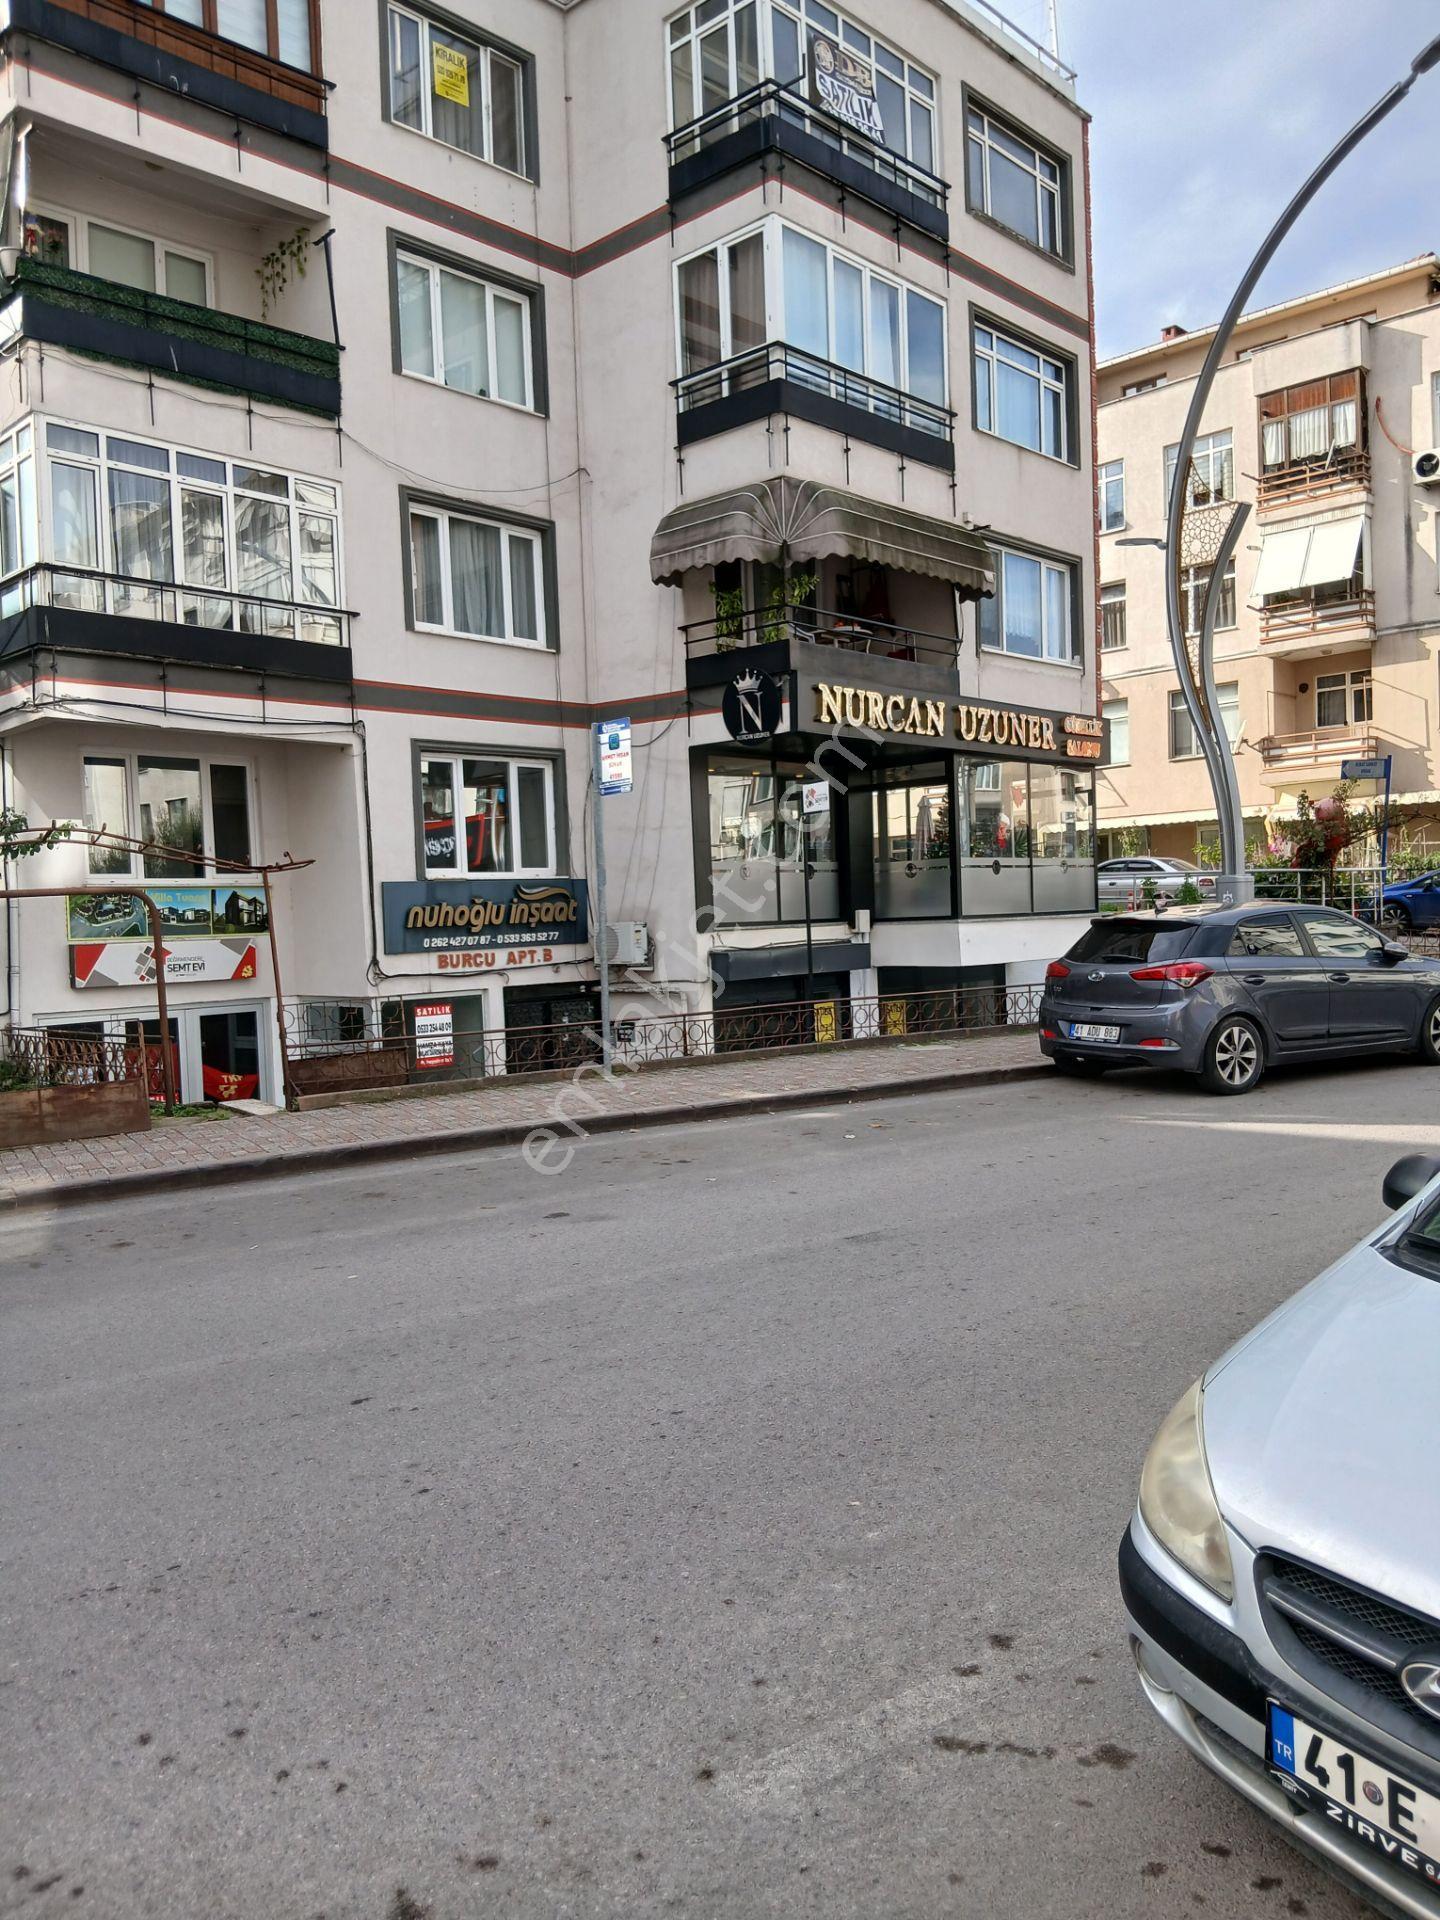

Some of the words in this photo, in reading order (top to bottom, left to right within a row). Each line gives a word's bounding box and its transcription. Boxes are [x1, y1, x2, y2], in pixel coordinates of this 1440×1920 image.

[818, 73, 879, 129] SATILIK
[817, 682, 945, 738] NURCAN
[957, 703, 1057, 750] UZUNER
[407, 898, 505, 933] nuhoğlu
[510, 897, 578, 928] inşaat
[431, 938, 448, 947] 262
[449, 937, 466, 946] 427
[467, 936, 479, 945] 07
[480, 935, 491, 945] 87
[504, 934, 520, 943] 533
[520, 933, 536, 943] 363
[537, 932, 548, 942] 52
[548, 931, 559, 941] 77
[167, 962, 192, 974] SEMT
[437, 952, 496, 970] BURCU
[416, 1005, 451, 1016] SATILIK
[1075, 1023, 1083, 1035] 41
[1274, 1738, 1292, 1761] TR
[1305, 1734, 1356, 1806] 41
[1387, 1776, 1418, 1844] E
